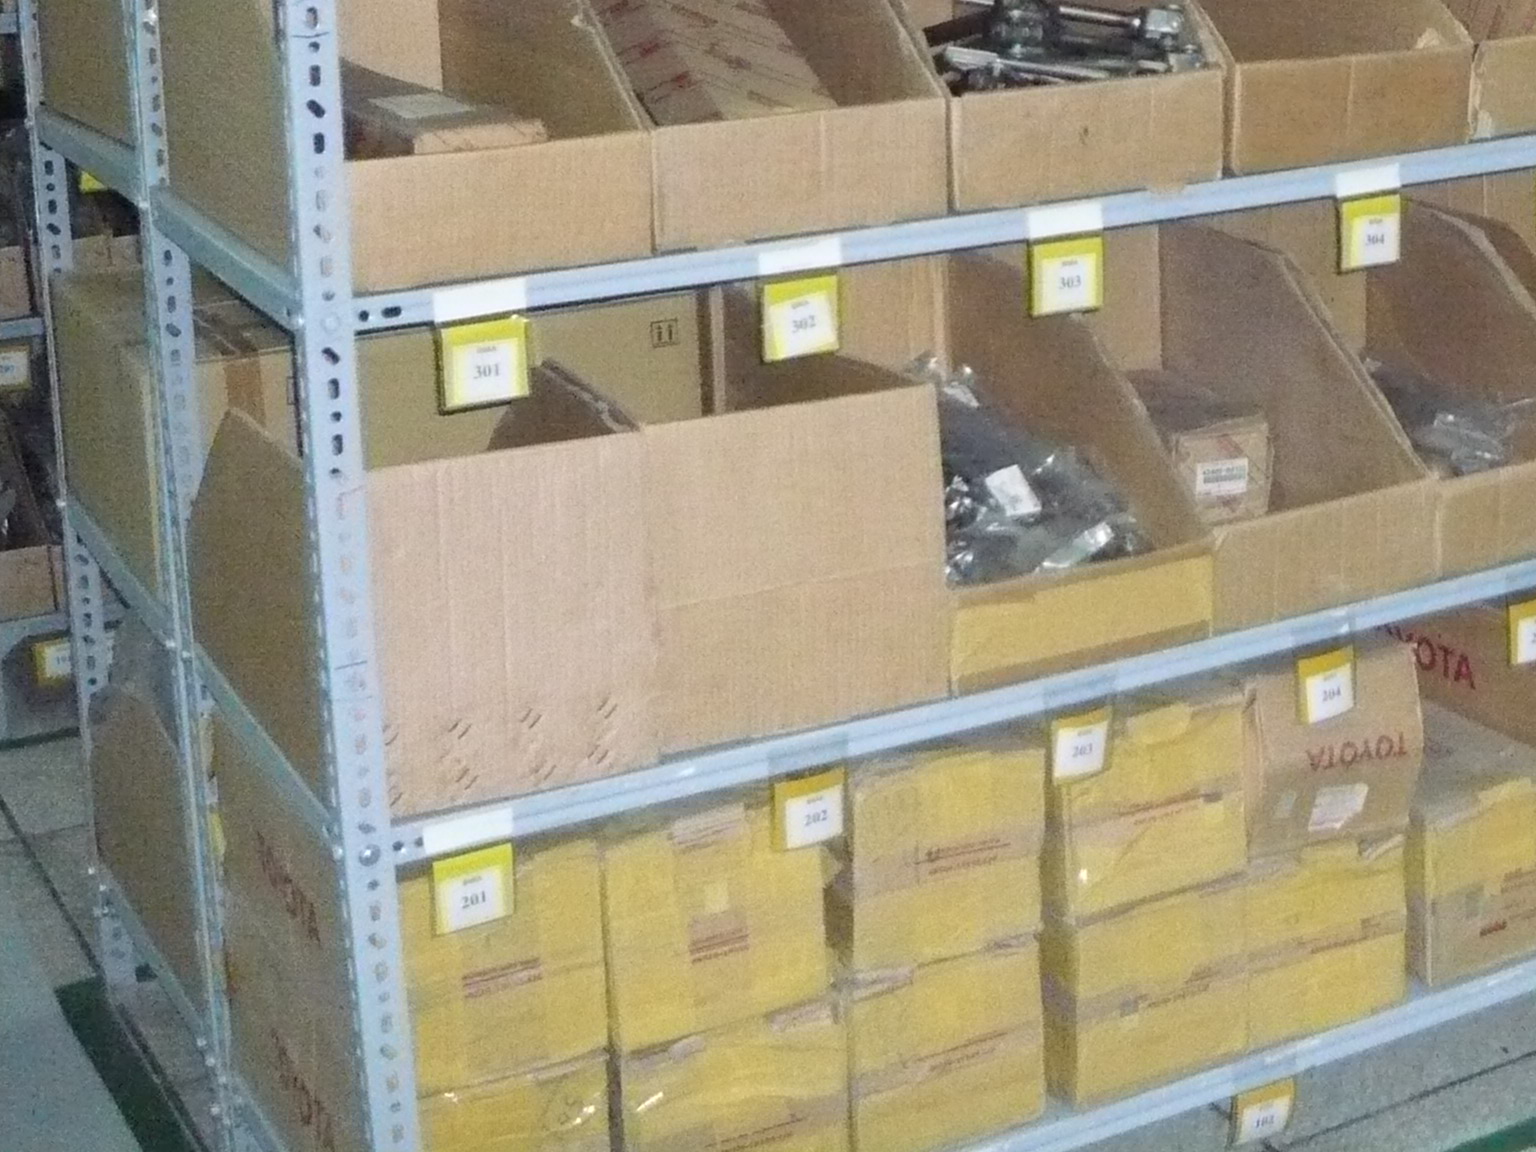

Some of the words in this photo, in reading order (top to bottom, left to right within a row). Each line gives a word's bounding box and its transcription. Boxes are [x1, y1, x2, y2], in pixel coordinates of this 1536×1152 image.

[1364, 231, 1386, 247] 304
[1058, 274, 1083, 291] 303
[790, 313, 817, 335] 302
[472, 363, 502, 381] 301
[1321, 686, 1342, 704] 204
[1071, 741, 1094, 759] 203
[1304, 732, 1409, 773] TOYOTA
[803, 805, 829, 828] 202
[460, 888, 489, 910] 201
